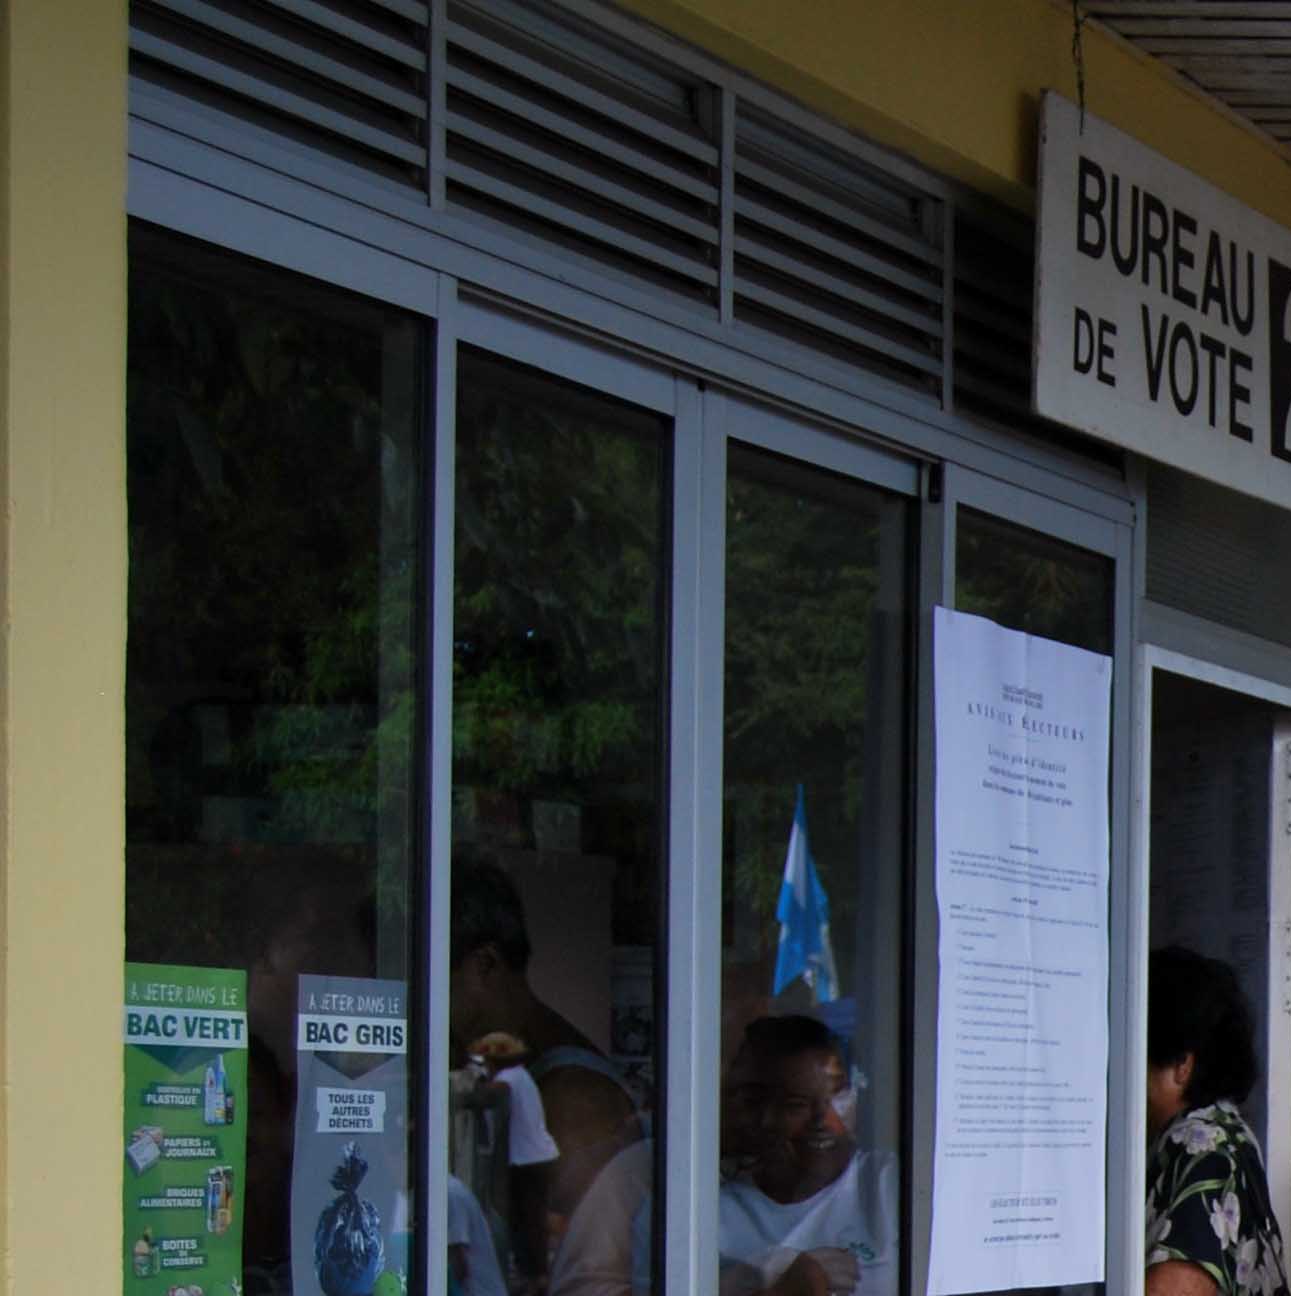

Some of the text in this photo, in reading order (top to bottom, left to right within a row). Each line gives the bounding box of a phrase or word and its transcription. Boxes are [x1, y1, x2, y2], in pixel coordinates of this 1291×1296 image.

[1077, 155, 1255, 337] BUREAU
[1073, 303, 1254, 443] DE VOTE
[143, 983, 183, 1004] JETER
[185, 985, 216, 1005] DANS
[221, 987, 240, 1006] LE
[320, 993, 354, 1012] JETER
[357, 995, 385, 1015] DANS
[387, 997, 400, 1014] LE
[127, 1013, 244, 1040] BAC VERT
[306, 1022, 404, 1047] BAC GRIS
[146, 1094, 197, 1105] PLASTIQUE
[328, 1094, 375, 1104] TOUS LES
[332, 1106, 371, 1116] AUTRES
[164, 1138, 201, 1147] PAPIERS
[165, 1148, 217, 1158] JOURNAUX
